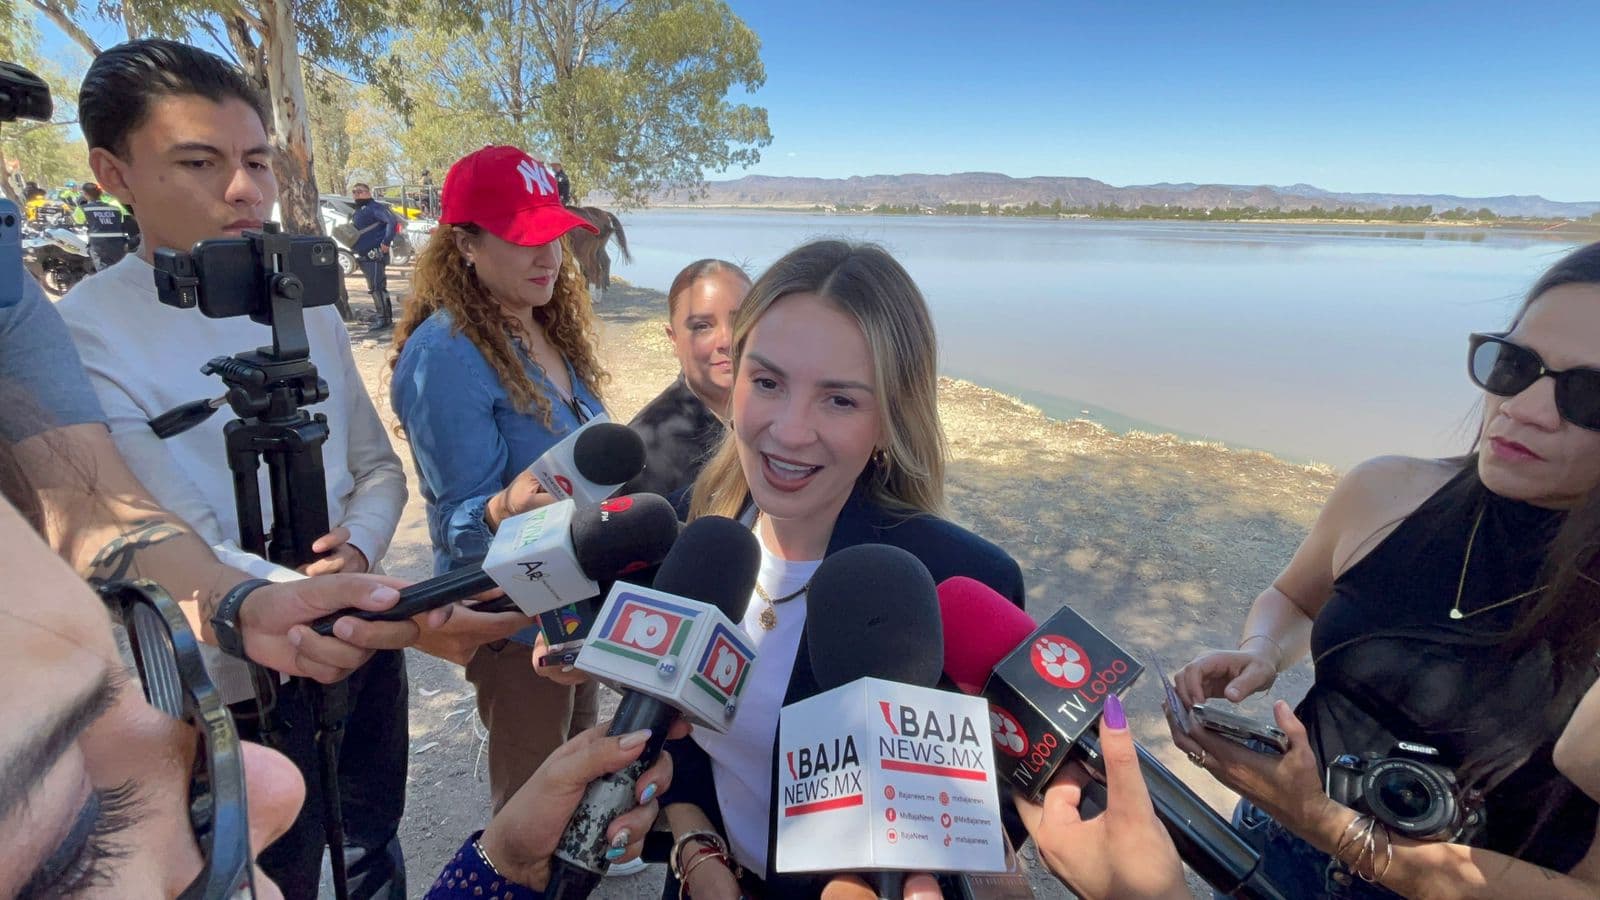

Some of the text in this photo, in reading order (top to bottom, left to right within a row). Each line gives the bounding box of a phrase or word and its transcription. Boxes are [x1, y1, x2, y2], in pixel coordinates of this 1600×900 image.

[517, 159, 555, 196] NY
[622, 609, 668, 649] 10
[659, 664, 676, 673] HD
[711, 645, 738, 688] 10
[900, 705, 981, 747] BAJA
[799, 735, 860, 779] BAJA
[879, 736, 985, 770] NEWS.MX
[1398, 742, 1439, 755] Canon
[784, 770, 862, 806] NEWS.MX
